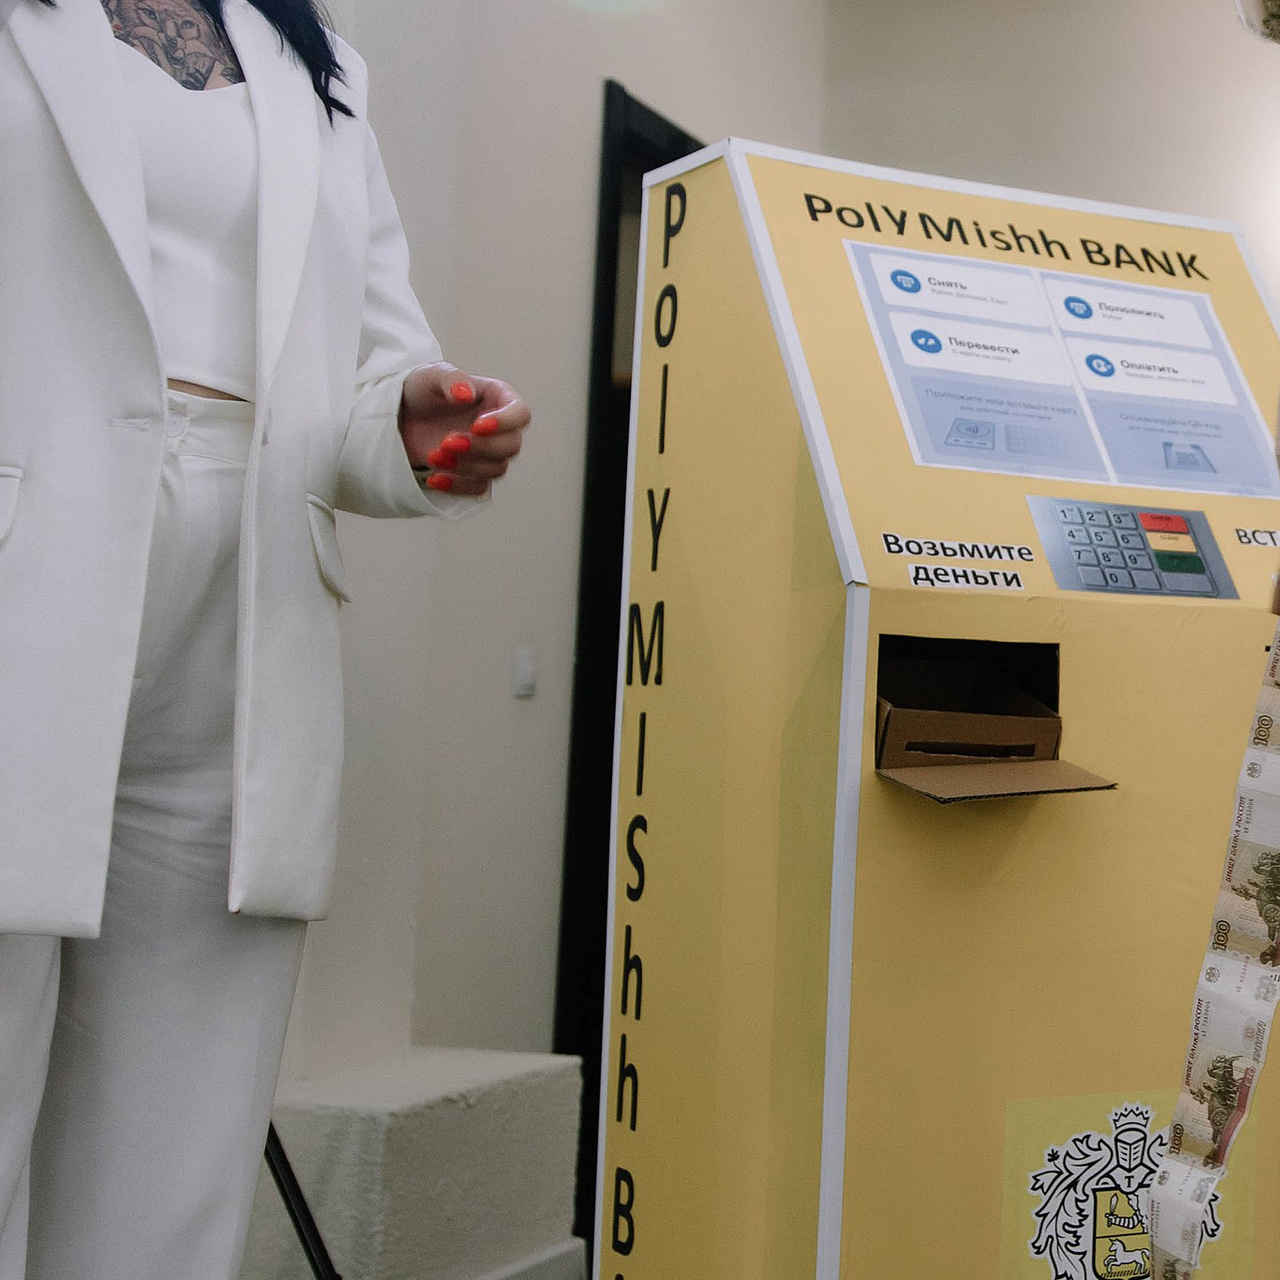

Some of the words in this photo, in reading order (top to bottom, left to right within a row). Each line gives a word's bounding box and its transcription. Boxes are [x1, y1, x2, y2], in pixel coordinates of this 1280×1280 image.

[1080, 237, 1209, 280] BANK
[928, 276, 967, 290] Снять
[948, 336, 1020, 355] Перевести
[1120, 360, 1179, 374] Оплатить
[1061, 510, 1068, 519] 1
[1087, 512, 1095, 521] 2
[1113, 514, 1122, 524] 3
[882, 533, 1034, 562] Возьмите
[1068, 530, 1076, 539] 4
[1095, 532, 1103, 542] 5
[1121, 534, 1130, 544] 6
[1074, 550, 1081, 560] 7
[1102, 552, 1110, 562] 8
[1129, 554, 1137, 564] 9
[913, 565, 1022, 588] деньги
[1110, 573, 1118, 583] 0
[1253, 714, 1274, 748] 100
[1235, 796, 1245, 827] РОССИИ
[1229, 829, 1240, 856] БАНКА
[1225, 857, 1234, 882] БИЛЕТ
[1212, 920, 1231, 953] 100
[1184, 1060, 1193, 1086] БИЛЕТ
[1193, 998, 1203, 1030] РОССИИ
[1169, 1124, 1184, 1156] 100
